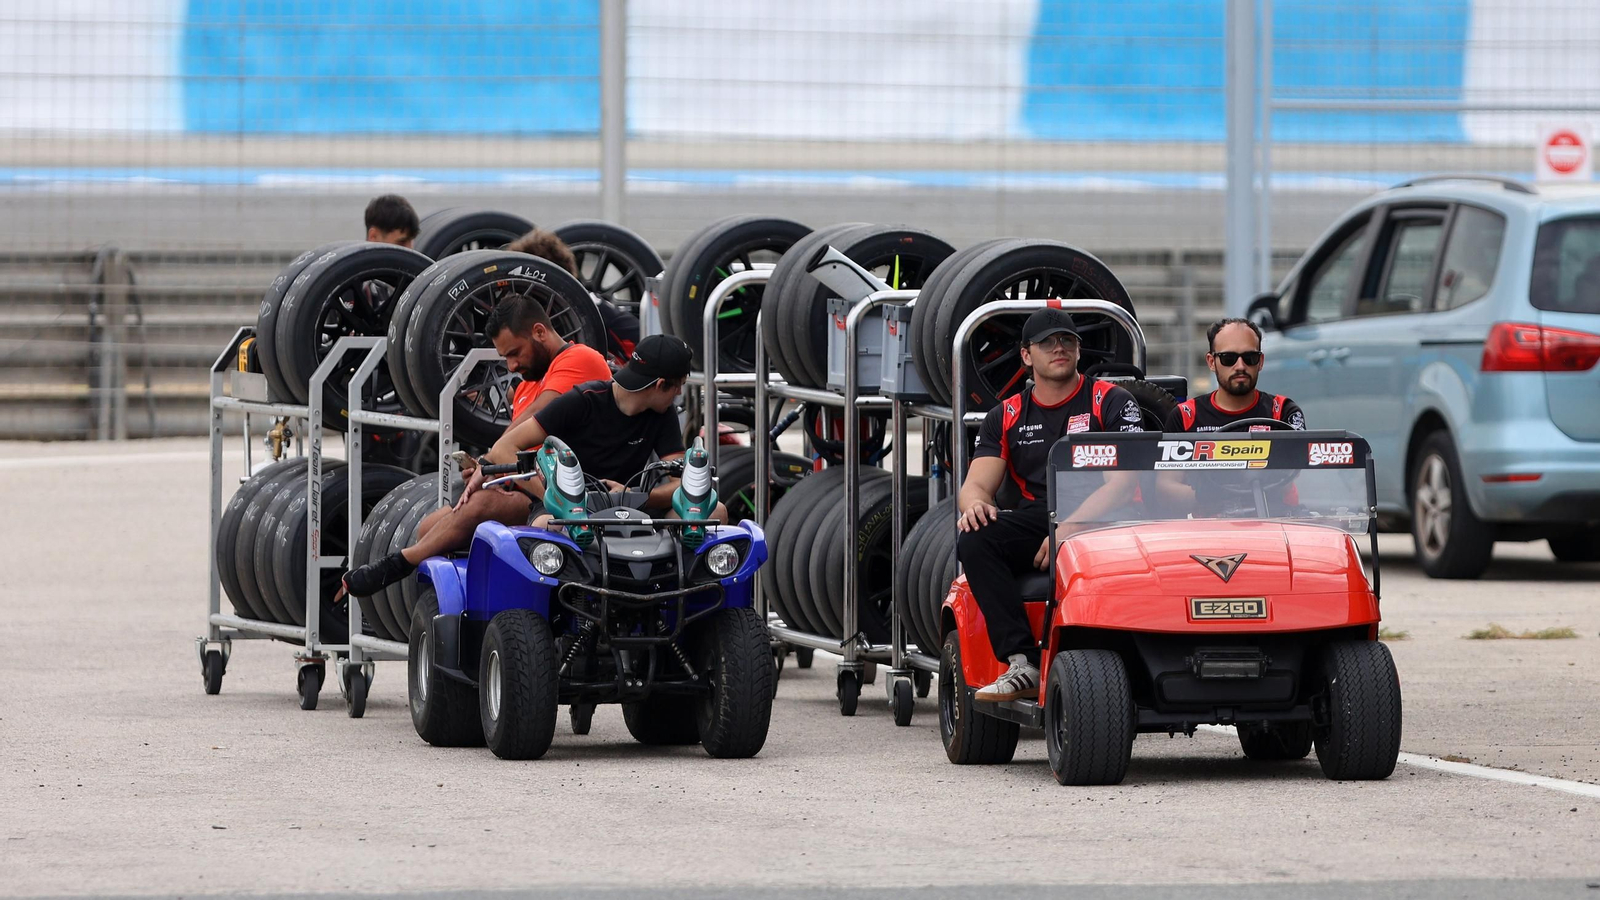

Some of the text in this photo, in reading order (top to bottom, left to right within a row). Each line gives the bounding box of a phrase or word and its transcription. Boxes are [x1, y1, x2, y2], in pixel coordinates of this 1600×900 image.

[1073, 445, 1117, 457] AUTO
[1157, 440, 1264, 461] TCR Spain
[1309, 443, 1352, 455] AUTO
[1073, 457, 1117, 468] SPORT
[1309, 454, 1352, 466] SPORT
[443, 461, 451, 492] Team
[311, 445, 321, 562] Team Clairet Sport
